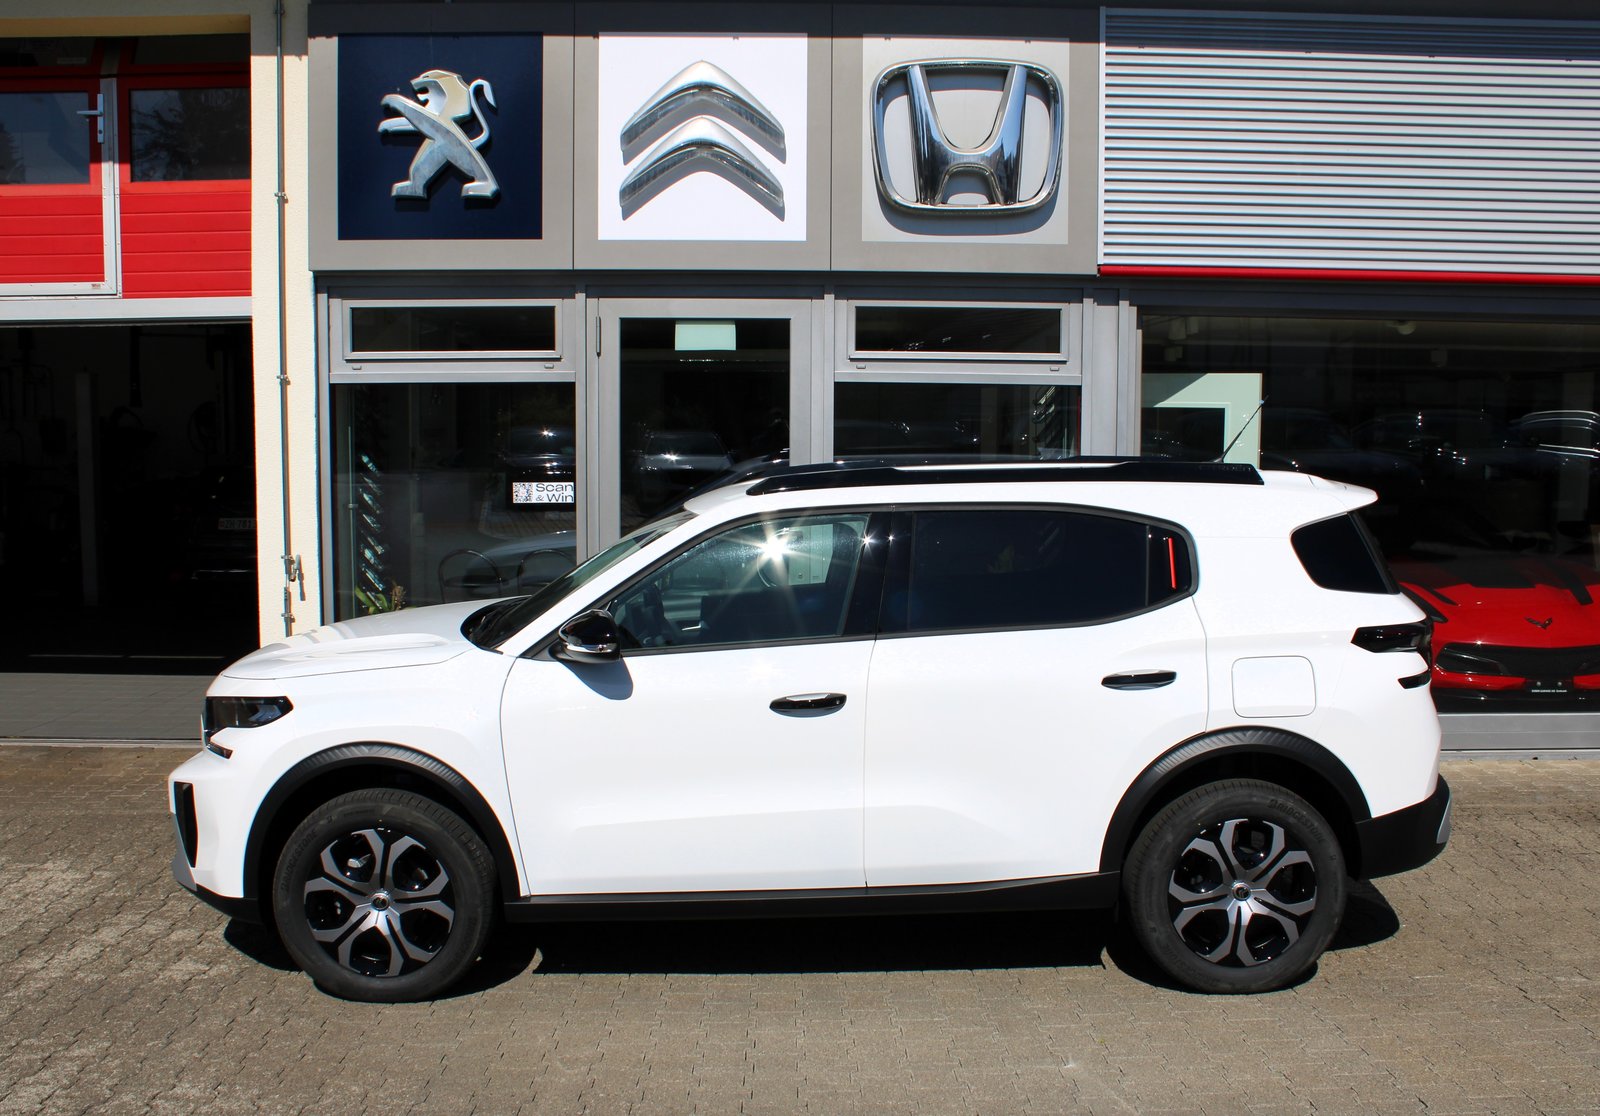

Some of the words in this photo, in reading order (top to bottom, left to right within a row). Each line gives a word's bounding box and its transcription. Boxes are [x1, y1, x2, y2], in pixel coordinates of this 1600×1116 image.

[535, 483, 574, 493] Scan
[535, 494, 544, 502] &
[546, 492, 574, 502] Win
